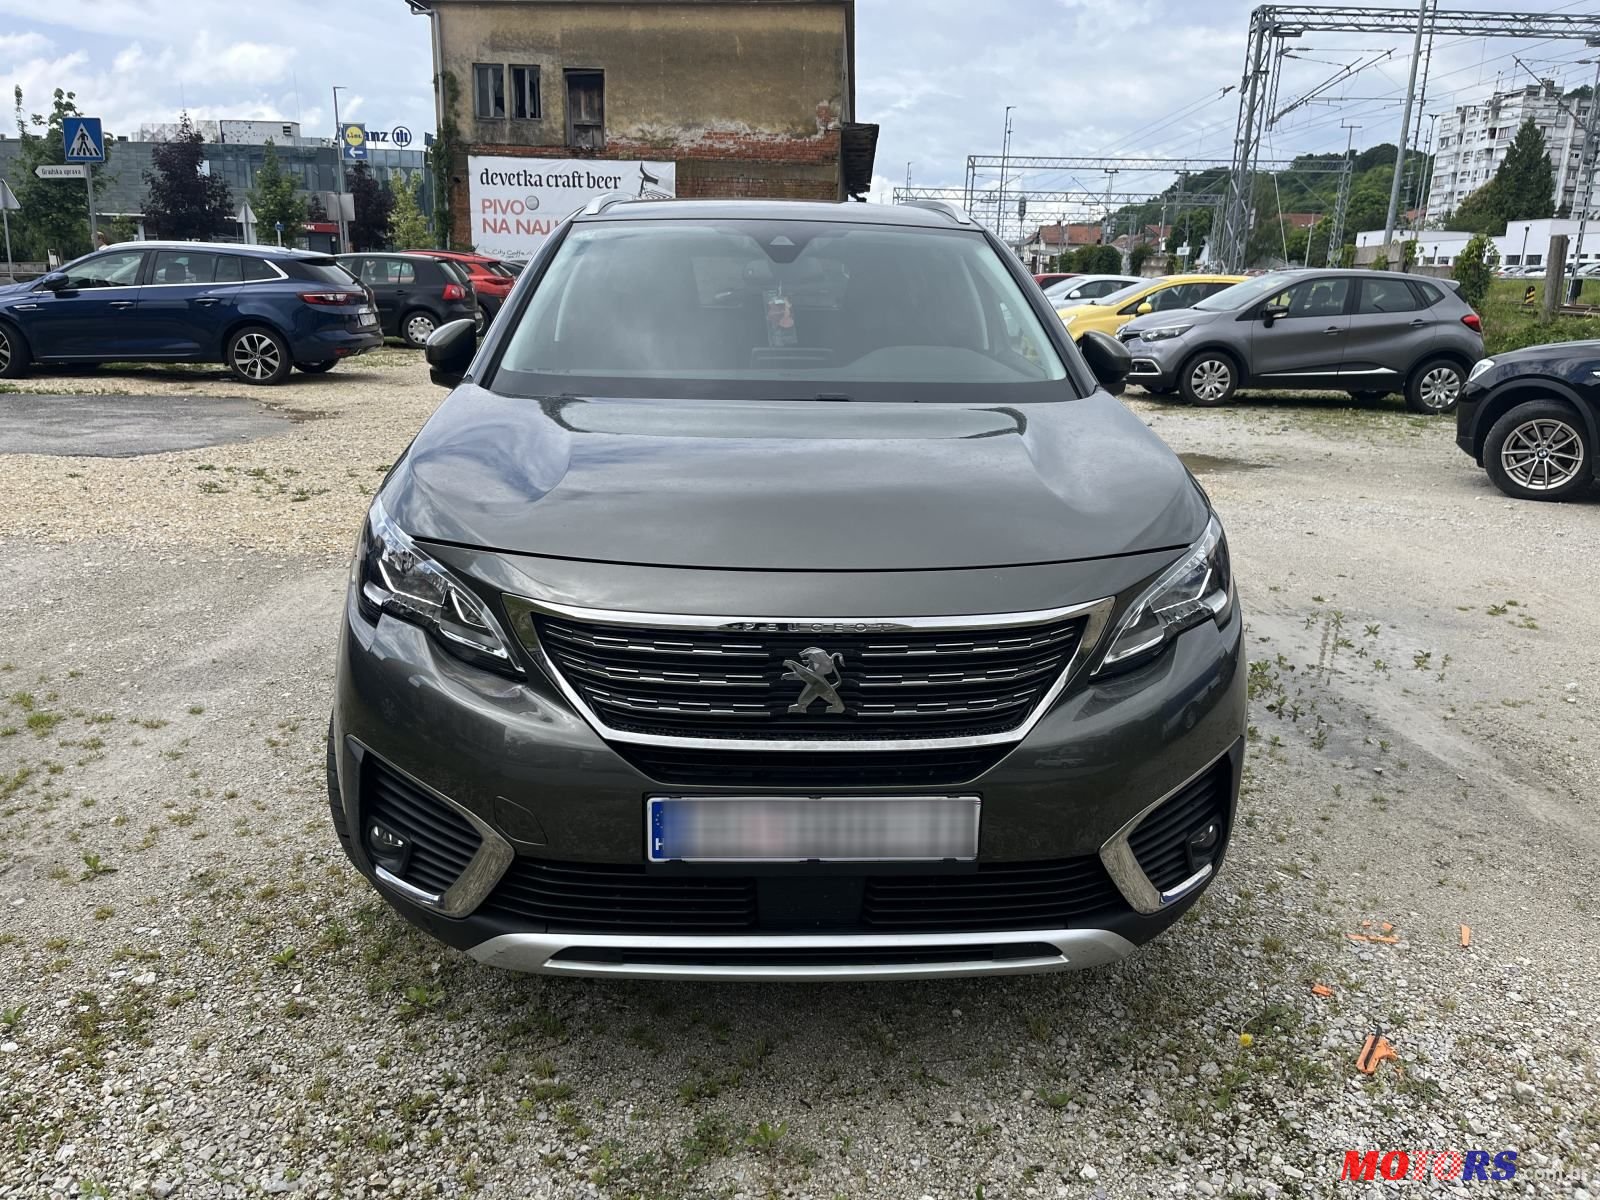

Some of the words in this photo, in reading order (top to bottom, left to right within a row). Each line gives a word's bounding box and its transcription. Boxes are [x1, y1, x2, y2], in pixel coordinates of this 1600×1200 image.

[480, 168, 542, 187] devetka
[546, 170, 584, 189] craft
[586, 171, 621, 190] beer
[481, 198, 525, 216] PIVO
[482, 217, 511, 234] NA
[743, 622, 895, 632] PEUGEOT
